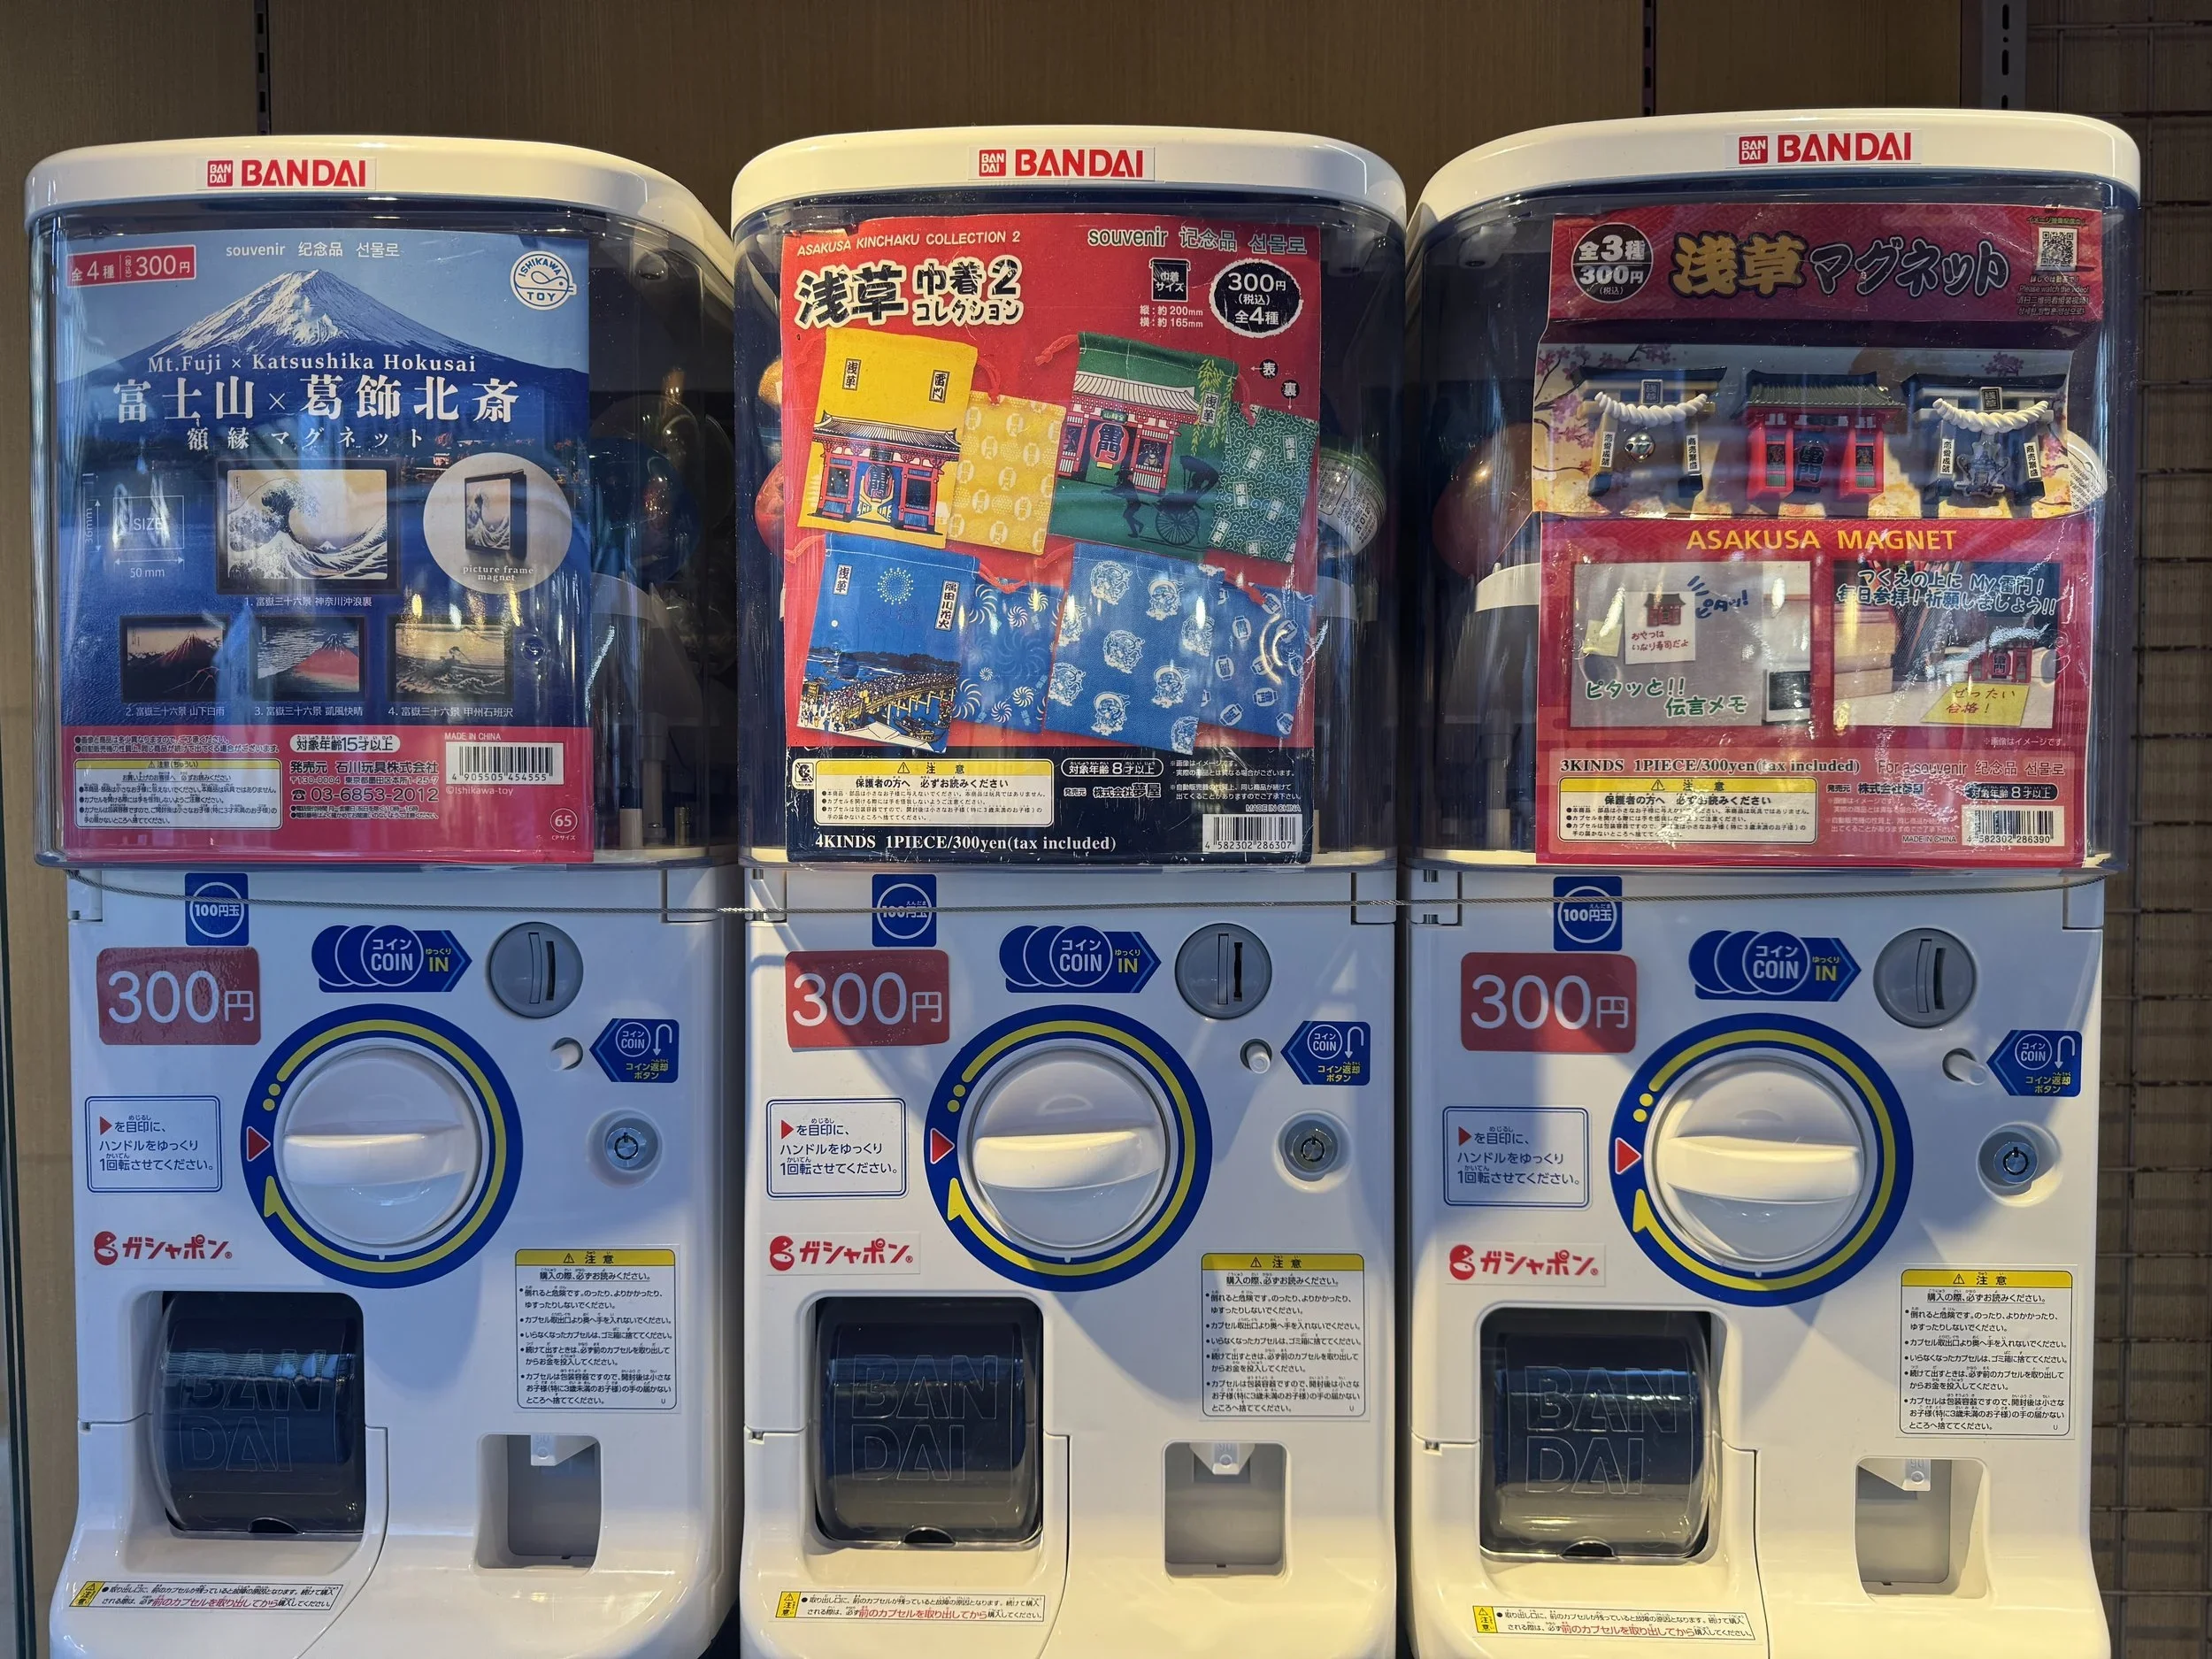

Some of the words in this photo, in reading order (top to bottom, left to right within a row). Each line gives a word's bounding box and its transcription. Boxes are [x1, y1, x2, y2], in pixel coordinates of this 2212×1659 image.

[1742, 140, 1766, 150] BAN
[1778, 133, 1911, 163] BANDAI
[982, 153, 1004, 163] BAN
[1742, 150, 1761, 160] DAI
[210, 164, 231, 173] BAN
[981, 164, 999, 173] DAI
[1016, 150, 1143, 177] BANDAI
[242, 160, 365, 187] BANDAI
[797, 240, 851, 257] ASAKUSA
[856, 234, 920, 249] KINCHAKU
[926, 232, 1006, 245] COLLECTION
[1012, 231, 1020, 242] 2
[1087, 227, 1169, 247] souvenir
[227, 242, 286, 257] souvenir
[298, 242, 343, 257] 纪念品
[356, 242, 400, 258] 선물로
[1248, 234, 1307, 255] 선물로
[1578, 234, 1645, 261] 全3種
[136, 255, 190, 276] 300円
[518, 257, 561, 277] ISHIKAWA
[1671, 233, 1807, 296] 浅草
[1809, 236, 2008, 297] マグネット
[1579, 265, 1644, 285] 300円
[1155, 282, 1184, 292] サイズ
[1227, 273, 1286, 292] 300円
[527, 292, 556, 301] TOY
[798, 264, 904, 324] 浅草
[1599, 287, 1624, 296] (税込)
[1238, 294, 1271, 305] (税込)
[917, 299, 1019, 322] コレクション
[1170, 305, 1203, 316] 200mm
[1234, 306, 1279, 326] 全4種
[1170, 319, 1203, 328] 165mm
[148, 354, 222, 374] Mt.Fuji
[252, 353, 374, 371] Katsushika
[384, 354, 476, 373] Hokusai
[1263, 362, 1275, 376] 表
[1284, 382, 1296, 396] 裏
[187, 426, 423, 450] 額縁マグネット
[134, 518, 163, 530] SIZE
[1686, 529, 1822, 550] ASAKUSA
[1838, 530, 1957, 550] MAGNET
[1857, 569, 1962, 588] つくえの上に
[1969, 573, 1996, 593] My
[315, 595, 372, 607] 神奈川沖浪裏
[1664, 695, 1747, 718] 伝言メモ
[290, 761, 327, 773] 発売元
[335, 761, 439, 774] 石川玩具株式会社
[1560, 759, 1624, 772] 3KINDS
[1791, 759, 1860, 772] included)
[1878, 759, 1898, 775] For
[1915, 762, 1968, 775] souvenir
[1975, 759, 2017, 775] 纪念品
[2025, 762, 2065, 777] 선물로
[856, 779, 911, 789] 保護者の方へ
[920, 779, 1009, 789] 必ずお読みください
[1093, 782, 1162, 798] 株式会社夢屋
[311, 787, 439, 802] 03-6853-2012
[1605, 795, 1665, 805] 保護者の方へ
[555, 815, 572, 827] 65
[815, 834, 876, 849] 4KINDS
[1042, 836, 1117, 853] included)
[195, 904, 241, 918] 100円玉
[1563, 908, 1612, 923] 100円玉
[373, 938, 411, 951] コイン
[1061, 939, 1102, 951] コイン
[1755, 945, 1799, 958] コイン
[371, 953, 413, 972] COIN
[429, 957, 449, 972] IN
[1059, 953, 1102, 972] COIN
[1118, 958, 1139, 973] IN
[1753, 960, 1799, 979] COIN
[1815, 965, 1837, 981] IN
[108, 970, 255, 1025] 300円
[793, 972, 942, 1028] 300円
[1471, 974, 1629, 1030] 300円
[621, 1039, 644, 1049] COIN
[1313, 1041, 1336, 1051] COIN
[2021, 1051, 2047, 1062] COIN
[626, 1063, 669, 1071] コイン返却
[1317, 1065, 1361, 1074] コイン返却
[2025, 1076, 2071, 1086] コイン返却
[2034, 1085, 2061, 1094] ボタン
[115, 1121, 165, 1133] を目印に、
[796, 1125, 849, 1136] を目印に、
[100, 1141, 198, 1151] ハンドルをゆっくり
[1474, 1133, 1529, 1145] を目印に、
[780, 1143, 882, 1155] ハンドルをゆっくり
[100, 1158, 213, 1171] 1回転させてください。
[1457, 1152, 1563, 1164] ハンドルをゆっくり
[780, 1163, 897, 1175] 1回転させてください。
[1457, 1171, 1579, 1185] 1回転させてください。
[585, 1254, 614, 1264] 注意
[1272, 1258, 1302, 1269] 注意
[1976, 1275, 2007, 1286] 注意
